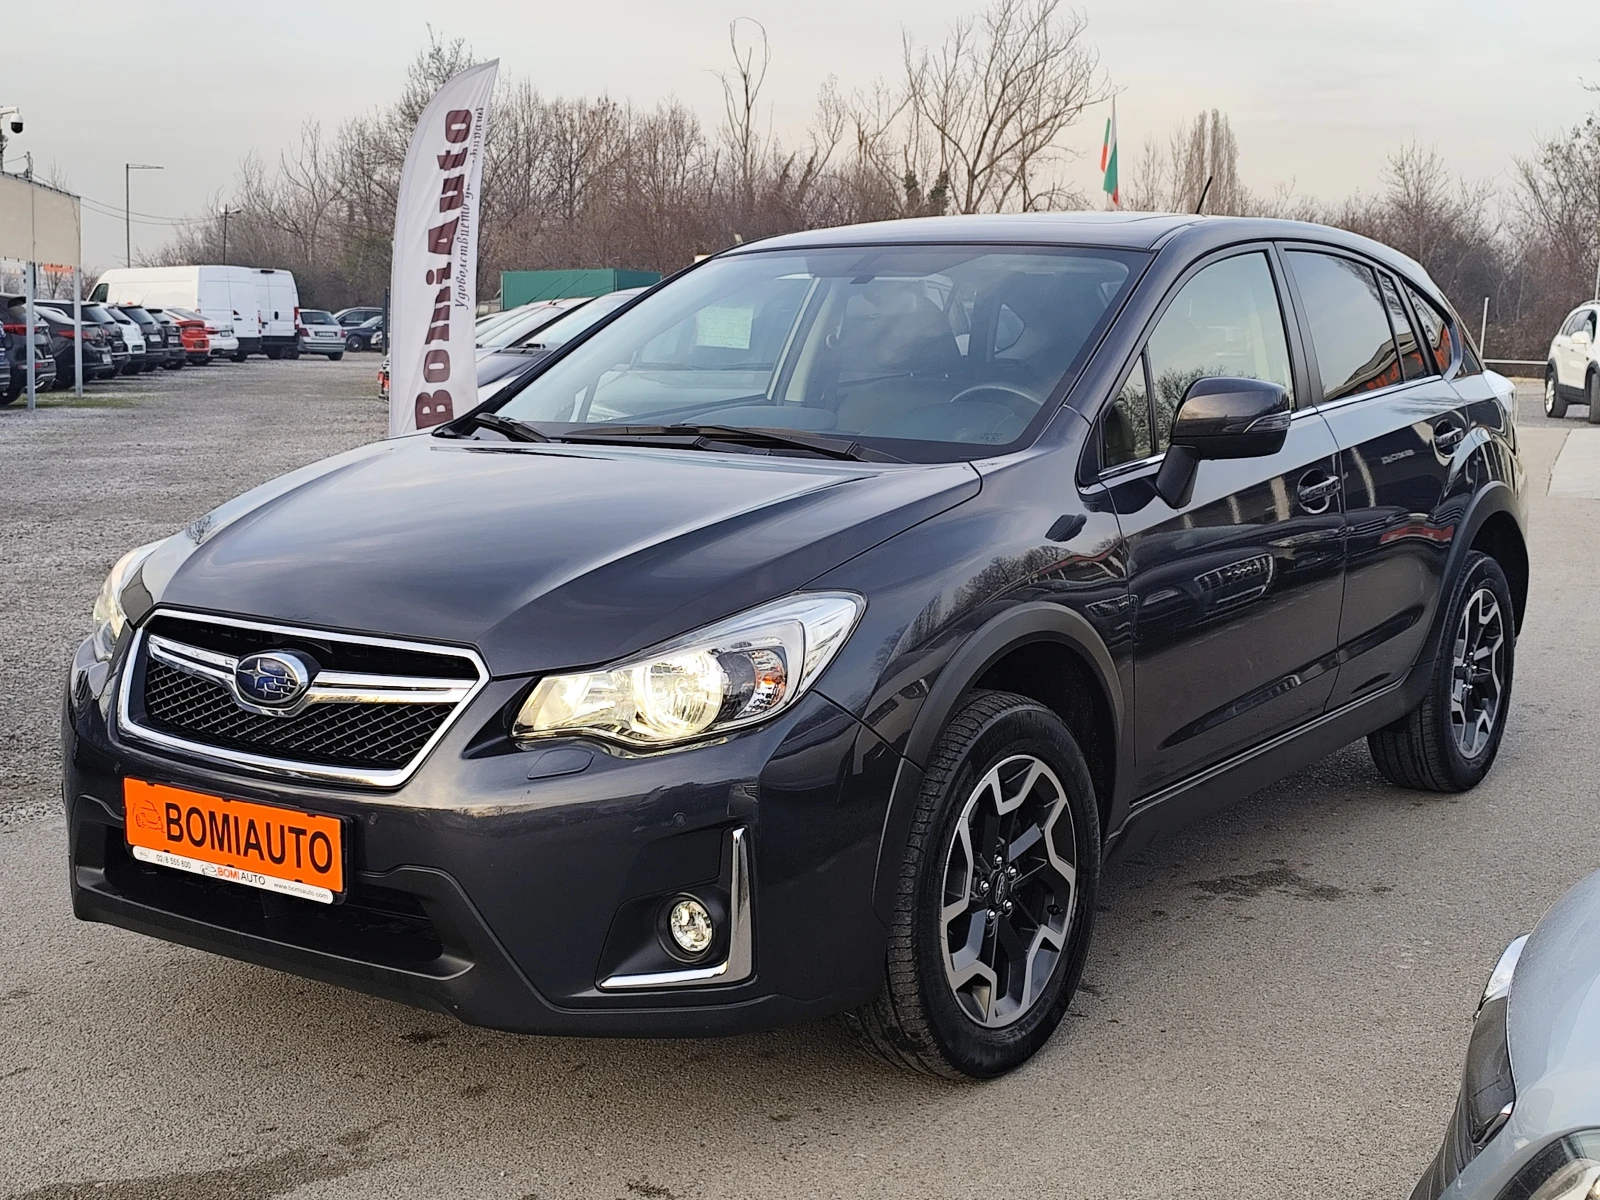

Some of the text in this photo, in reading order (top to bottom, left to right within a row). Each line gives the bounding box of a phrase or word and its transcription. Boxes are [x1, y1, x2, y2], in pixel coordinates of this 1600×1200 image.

[164, 802, 333, 874] BOMIAUTO
[170, 858, 181, 867] 555
[217, 867, 266, 885] BOMI AUTO
